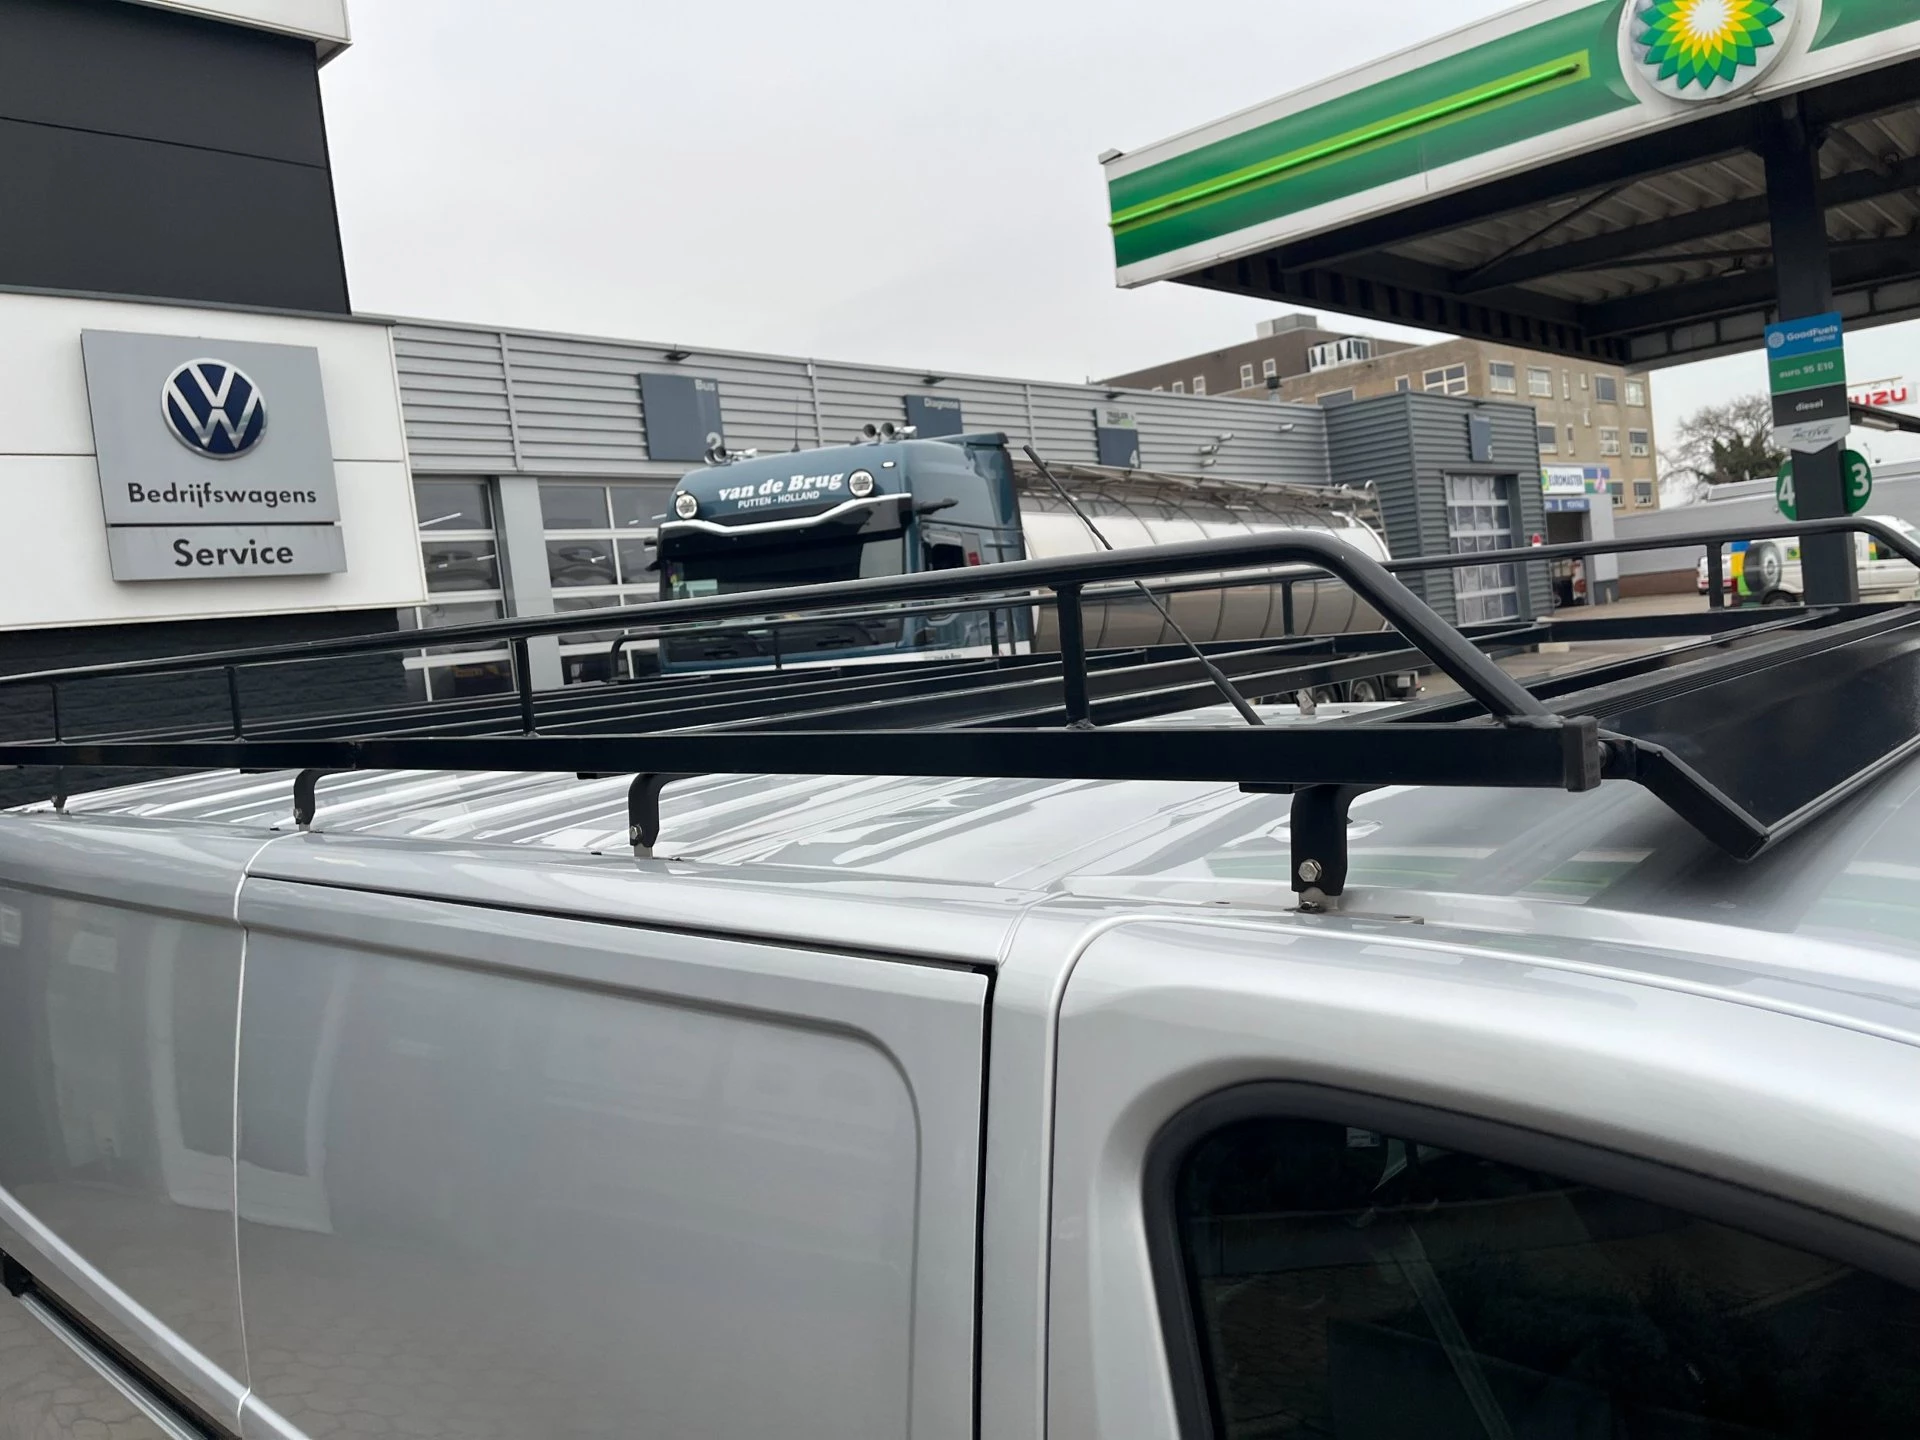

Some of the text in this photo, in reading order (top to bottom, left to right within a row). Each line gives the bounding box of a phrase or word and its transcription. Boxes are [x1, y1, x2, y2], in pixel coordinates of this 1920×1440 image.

[1786, 324, 1838, 342] GoodFuels
[1779, 360, 1834, 379] euro 95 E10
[694, 379, 716, 392] Bus
[1795, 399, 1824, 412] diesel
[1848, 387, 1907, 408] UZU
[1129, 449, 1139, 468] 4
[718, 472, 845, 501] van de Brug
[1851, 462, 1870, 497] 3
[127, 482, 317, 509] Bedrijfswagens
[737, 496, 772, 509] PUTTEN
[777, 490, 820, 504] HOLLAND
[1778, 475, 1796, 507] 4
[173, 538, 294, 567] Service
